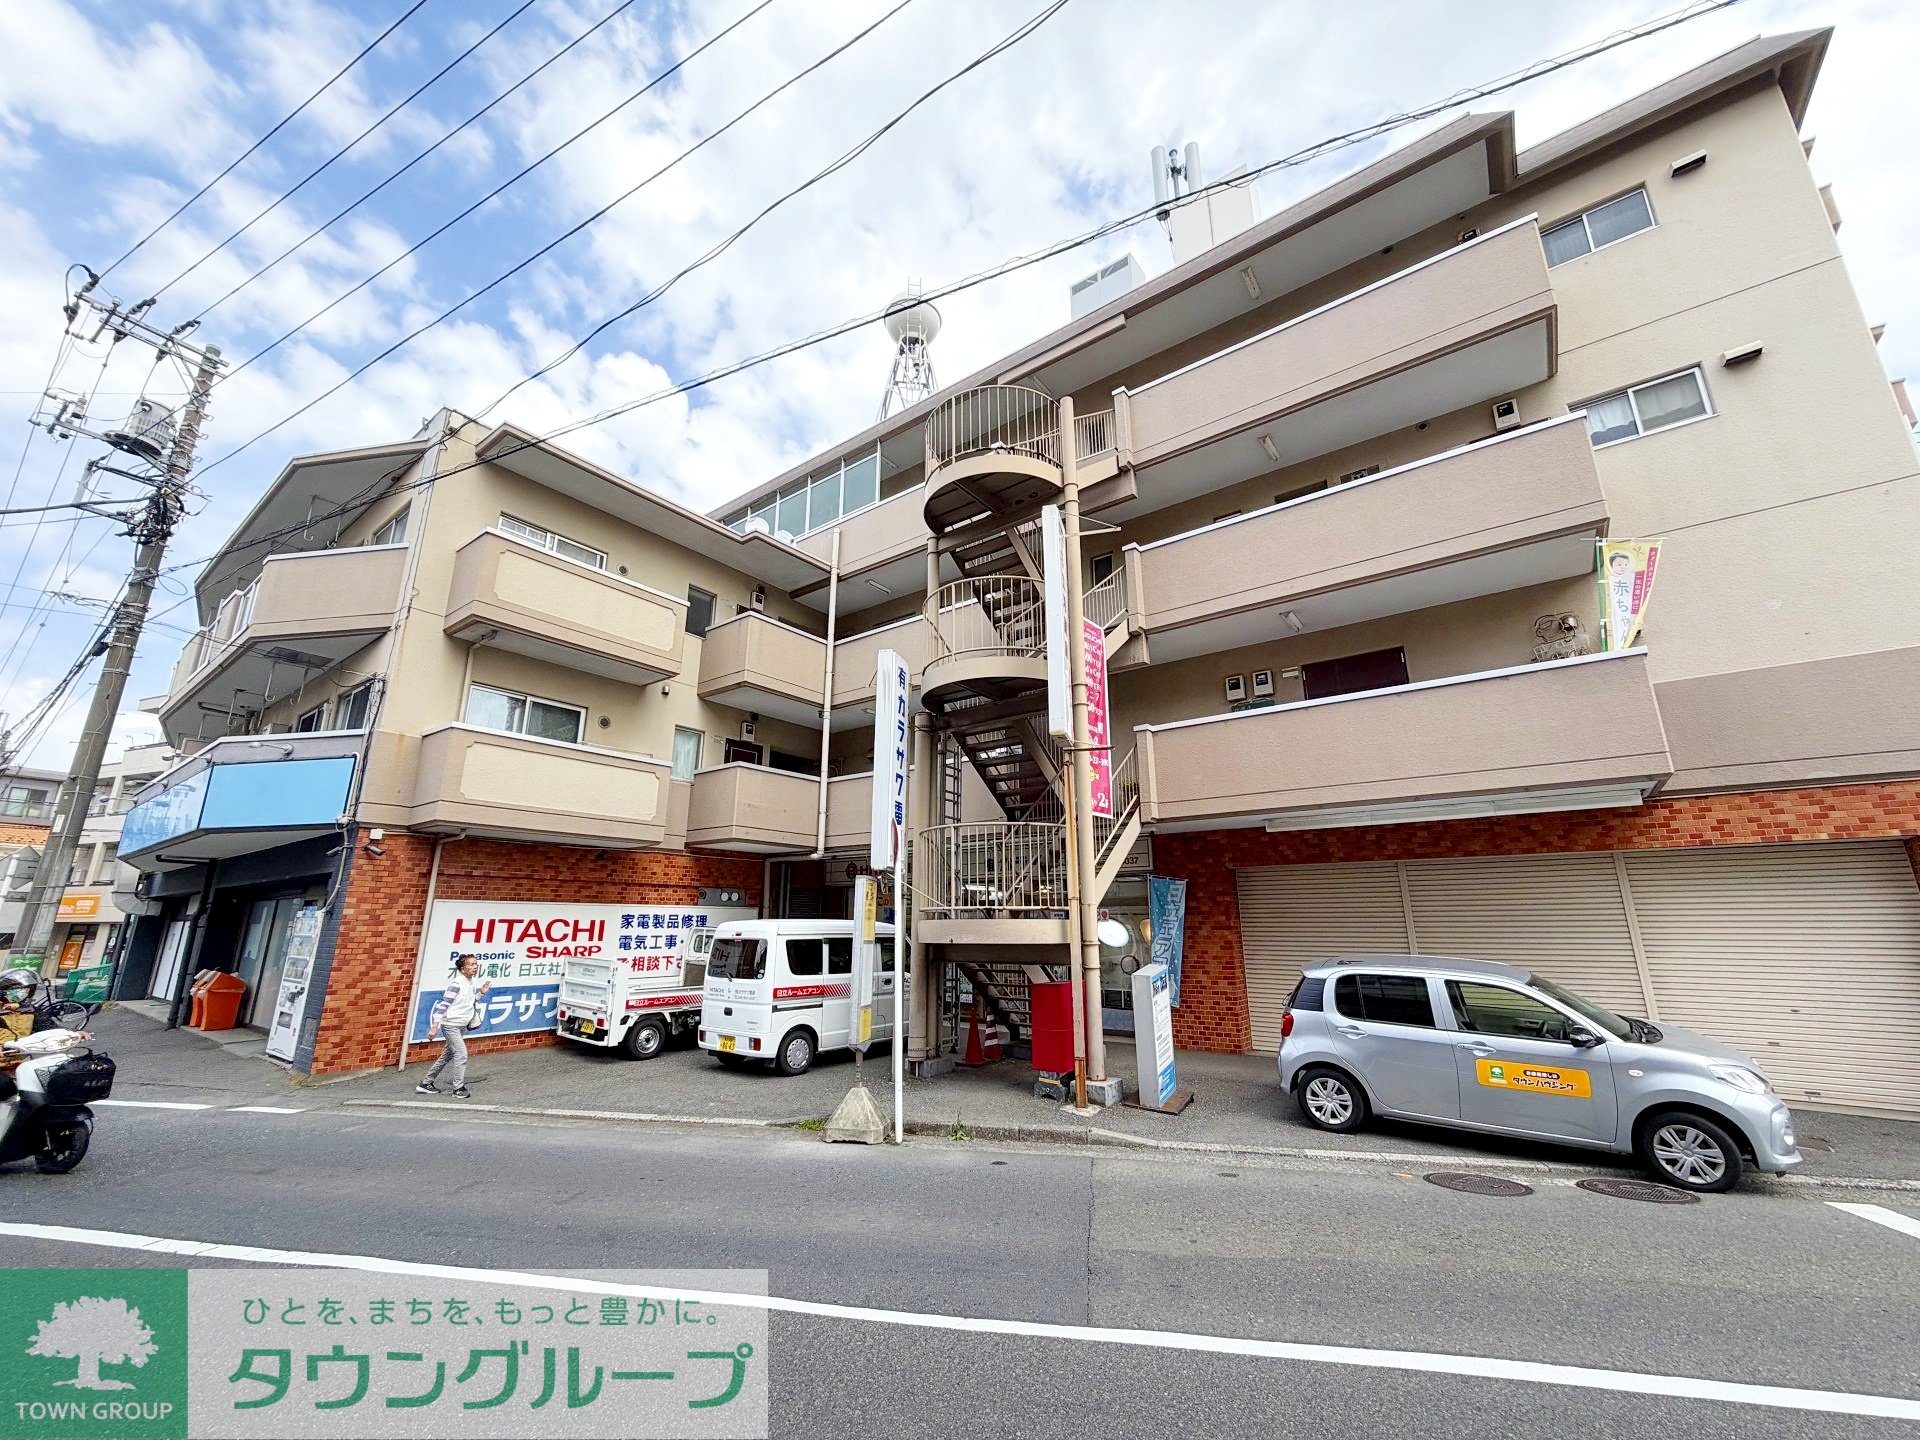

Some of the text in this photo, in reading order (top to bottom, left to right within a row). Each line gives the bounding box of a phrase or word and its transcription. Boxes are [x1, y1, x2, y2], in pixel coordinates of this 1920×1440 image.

[1123, 857, 1139, 865] 037
[620, 914, 708, 929] 家電製品修理
[453, 918, 606, 943] HITACHI
[449, 950, 516, 961] Pasonic
[525, 945, 602, 959] SHARP
[447, 963, 511, 979] オル電化
[776, 987, 822, 998] 日立ルームエアコン
[1512, 1077, 1578, 1091] タウンハウジング
